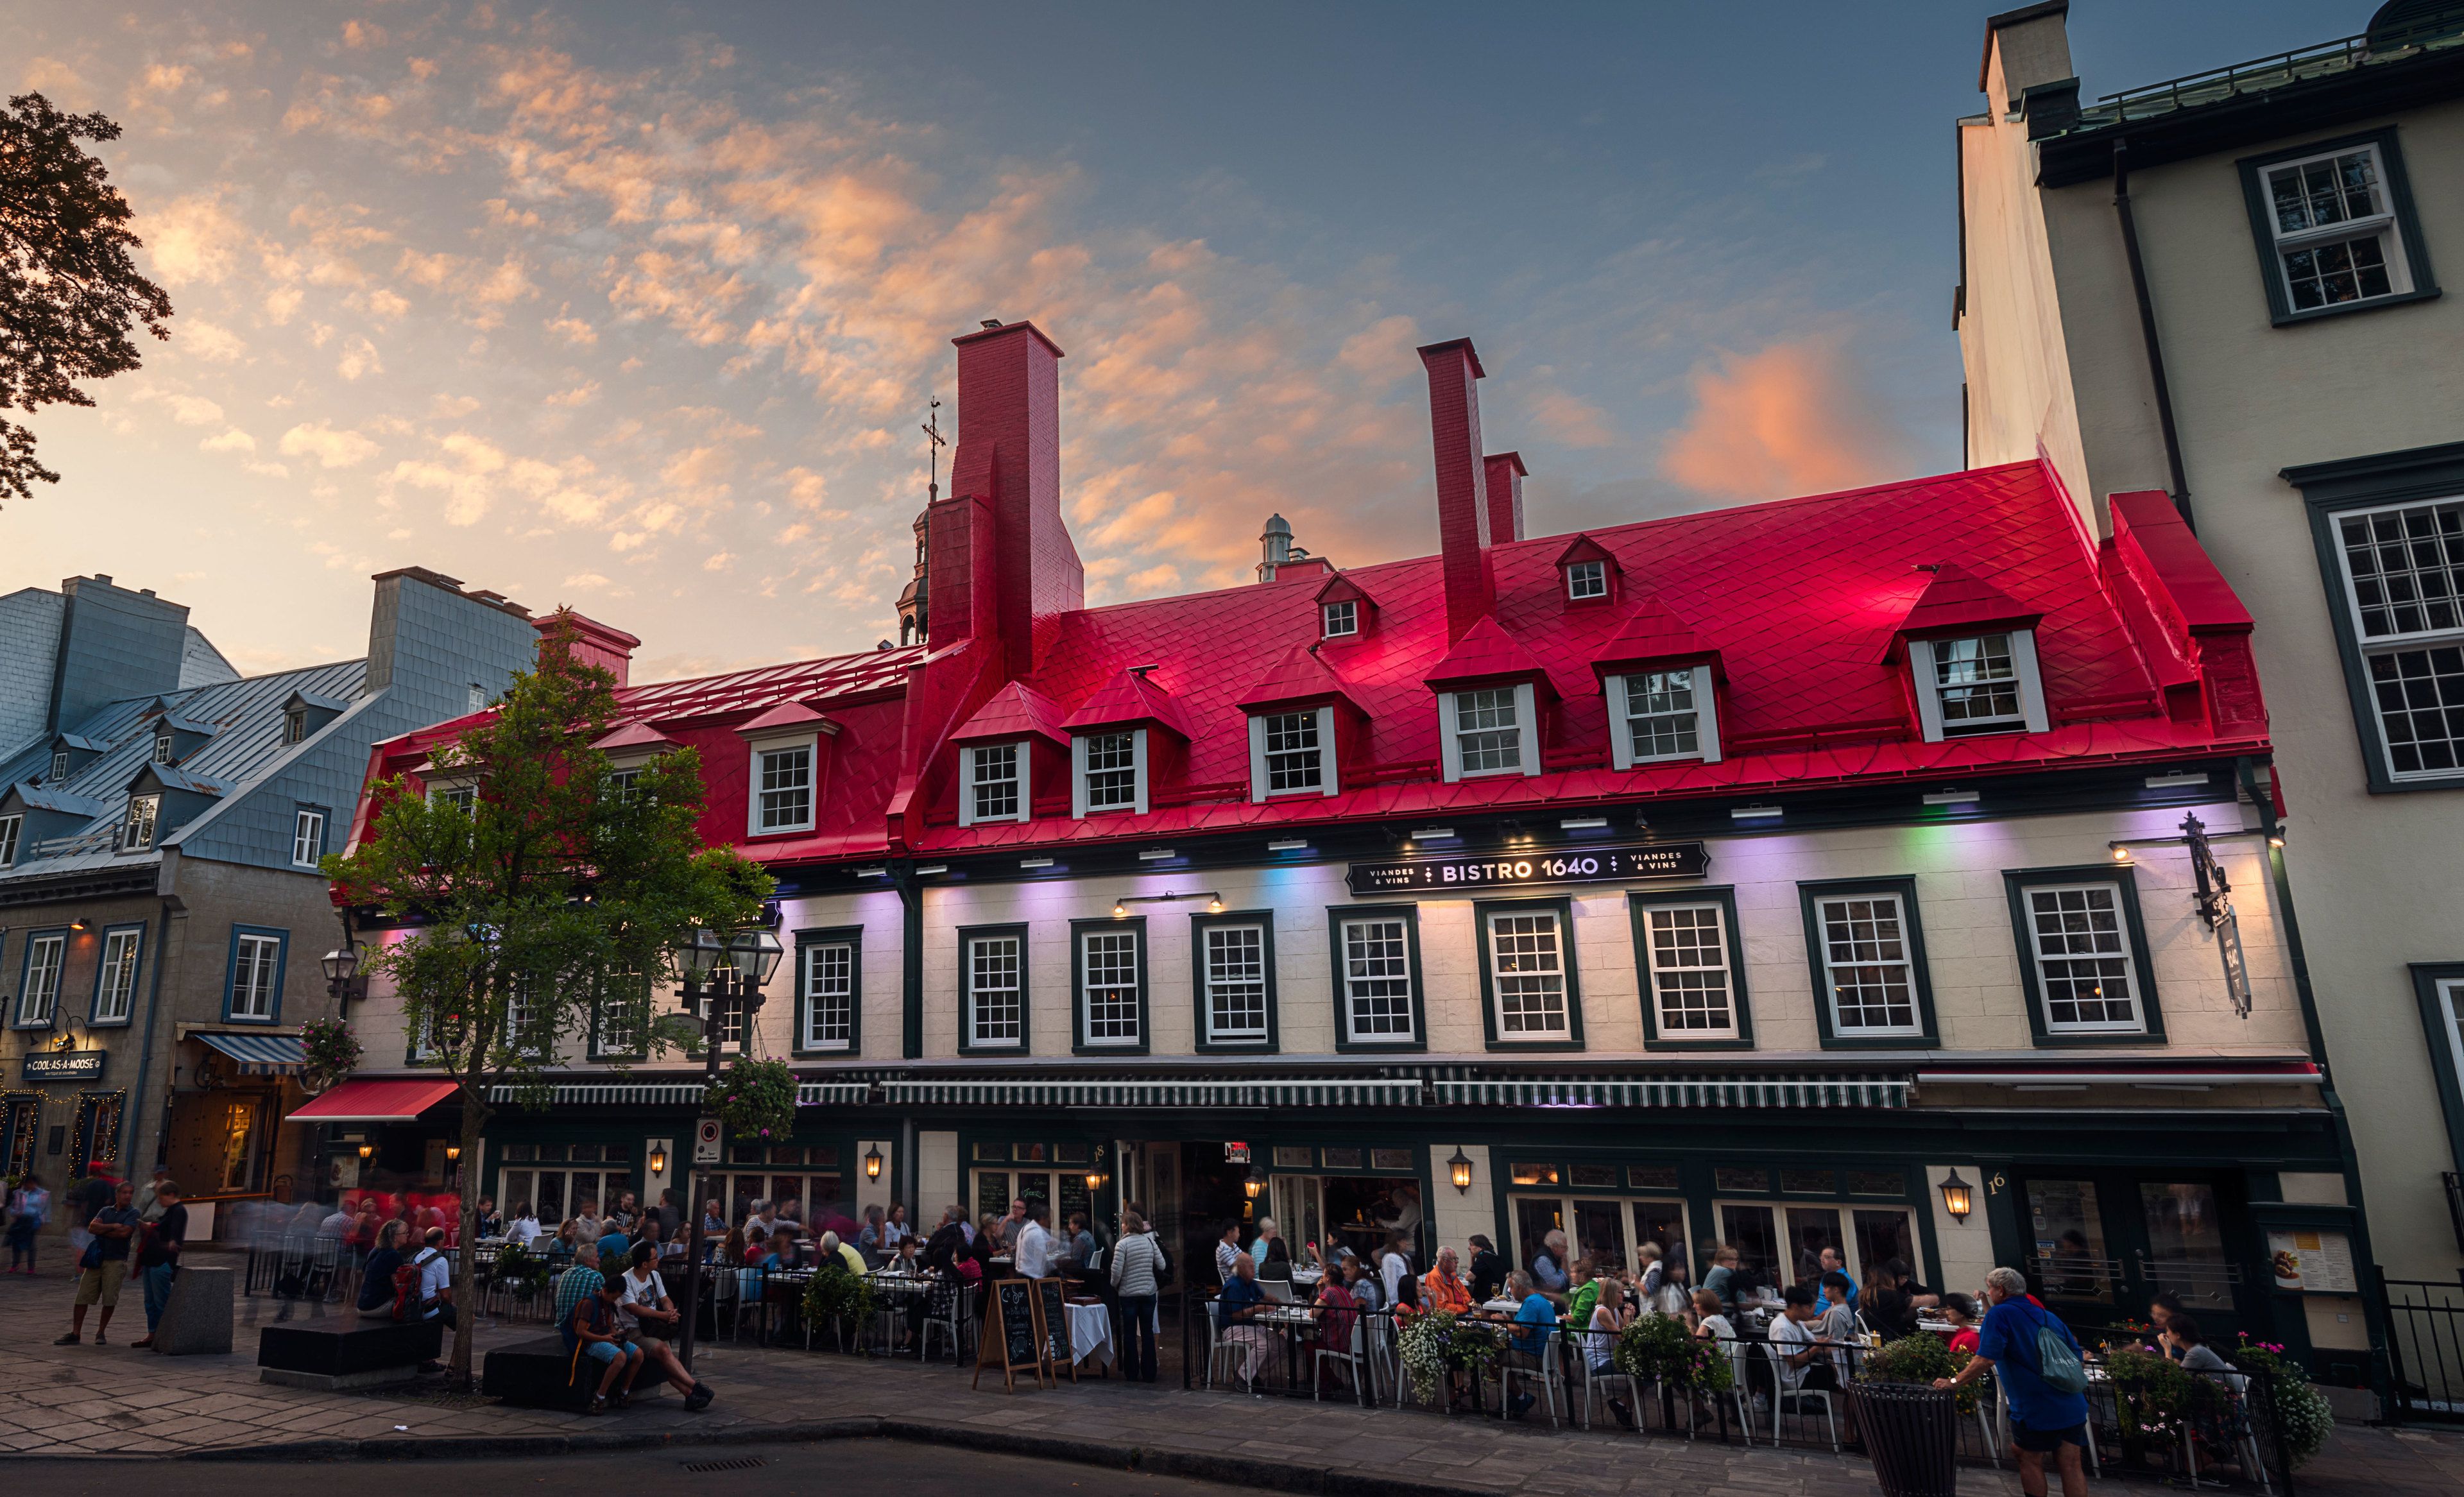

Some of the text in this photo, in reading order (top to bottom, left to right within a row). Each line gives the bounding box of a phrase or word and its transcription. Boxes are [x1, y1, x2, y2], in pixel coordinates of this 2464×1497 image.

[1630, 852, 1682, 861] VIANDES
[1370, 868, 1414, 877] VIANDES
[1442, 857, 1598, 882] BISTRO 1640
[1094, 1145, 1104, 1163] 18
[1988, 1172, 2005, 1195] 16
